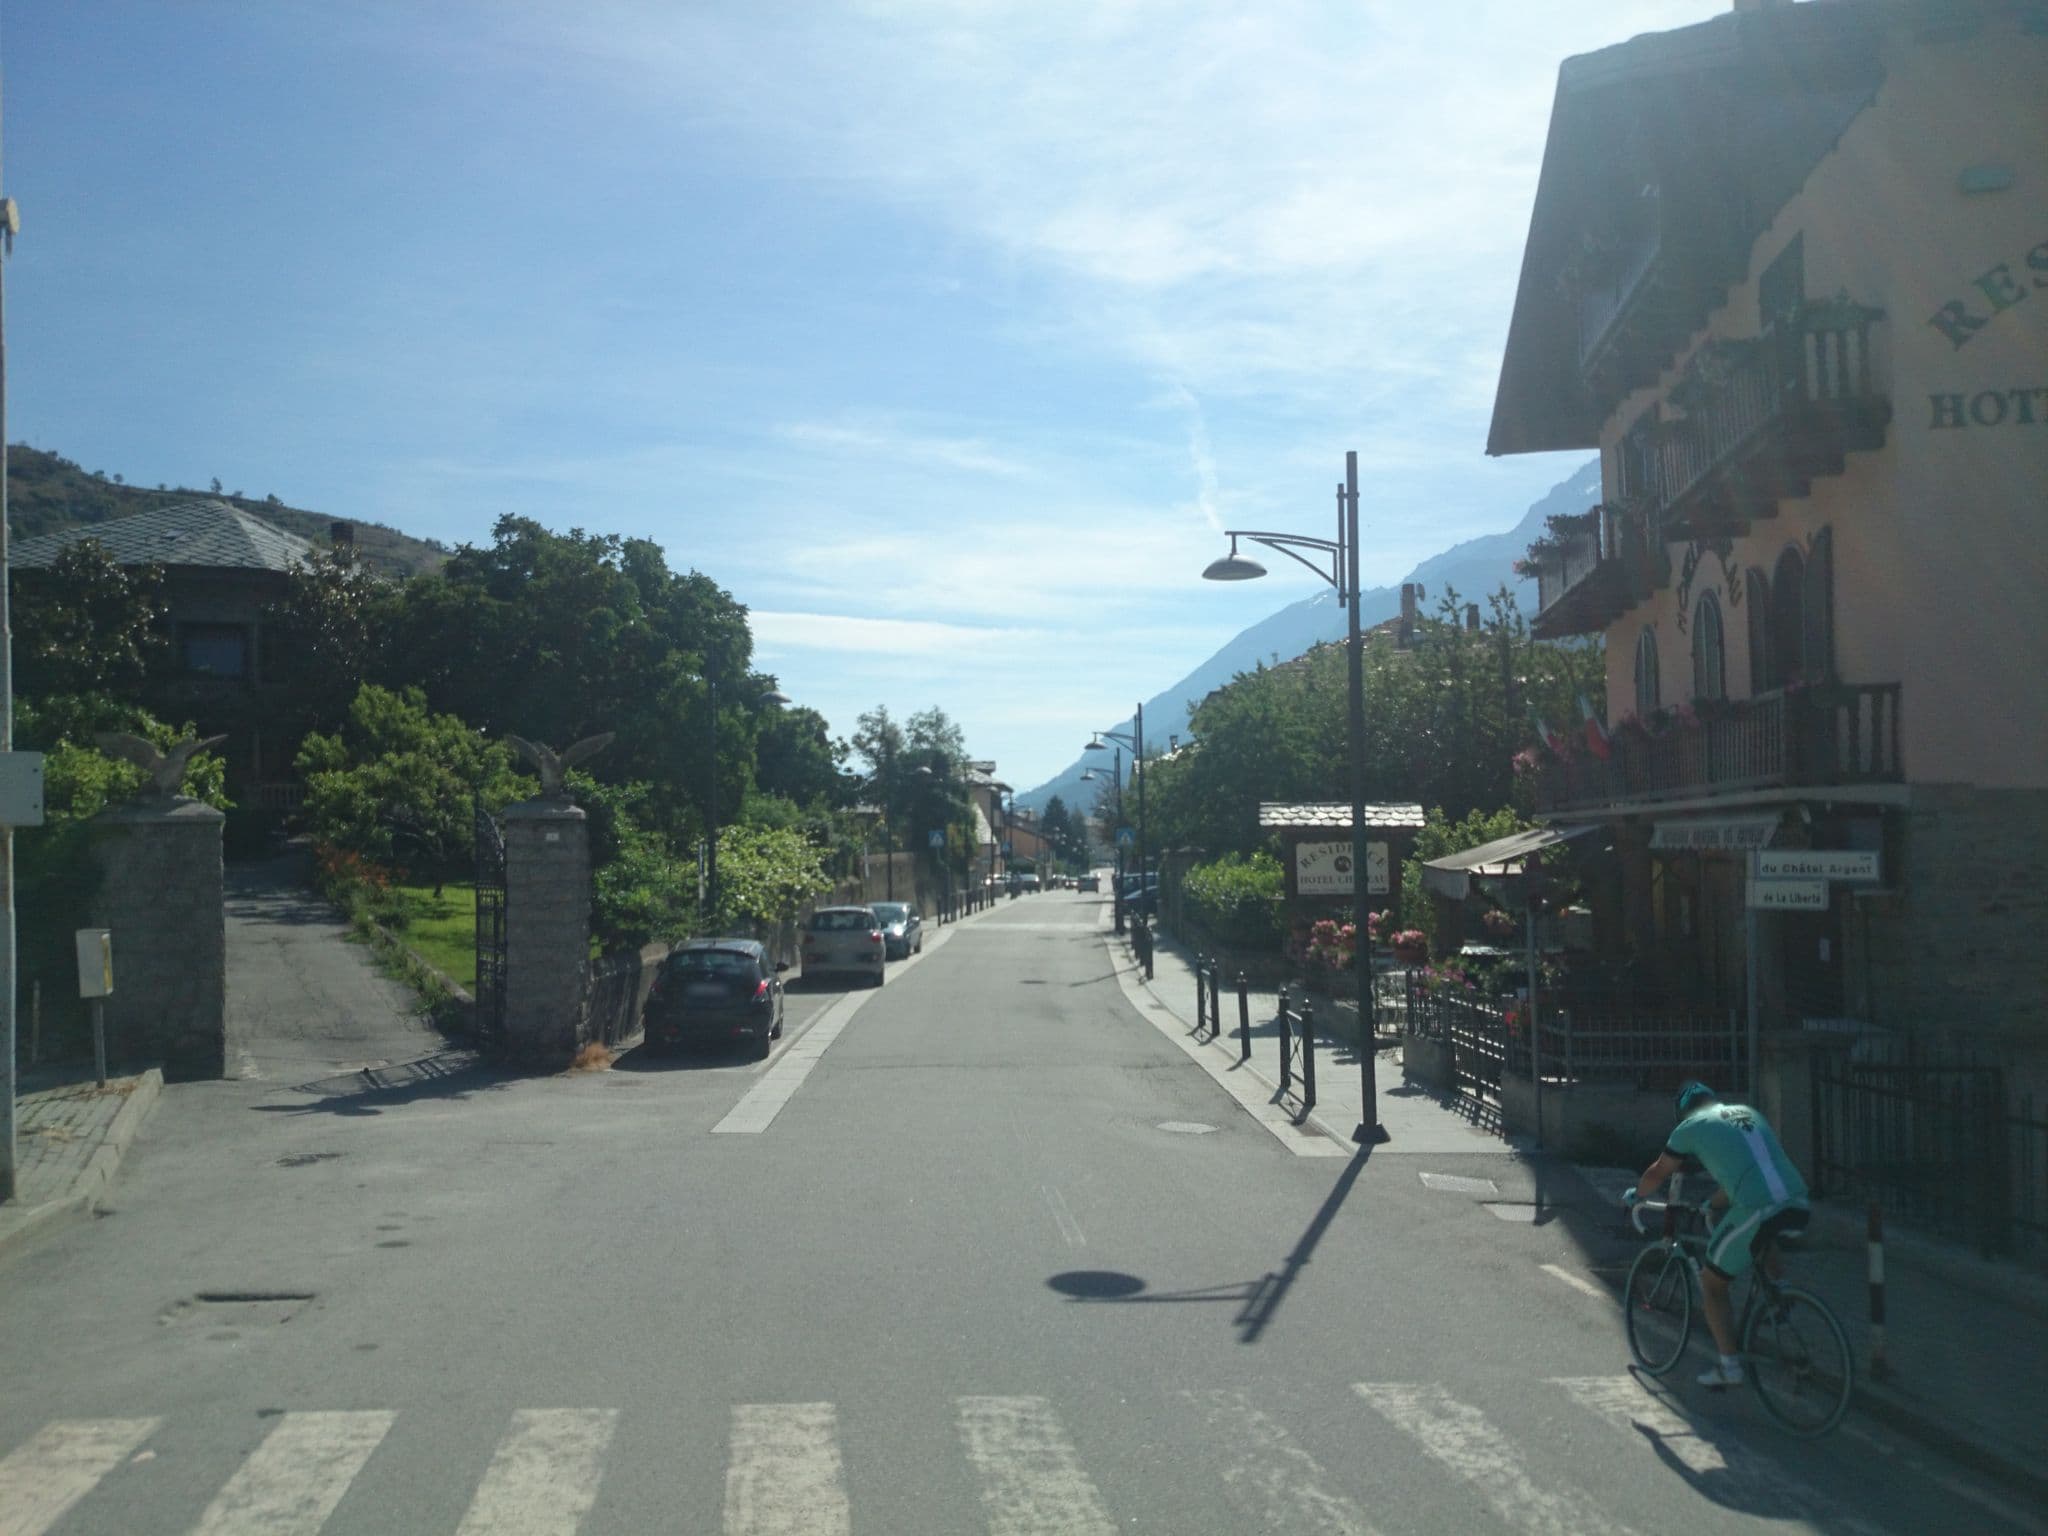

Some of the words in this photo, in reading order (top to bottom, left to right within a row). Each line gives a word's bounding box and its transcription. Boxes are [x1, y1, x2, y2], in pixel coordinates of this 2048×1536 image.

[1928, 387, 2048, 430] HOT
[1299, 843, 1386, 869] RESIDECE
[1761, 863, 1777, 873] du
[1829, 863, 1872, 875] Argent
[1300, 875, 1335, 884] HOTEL
[1763, 892, 1774, 903] de
